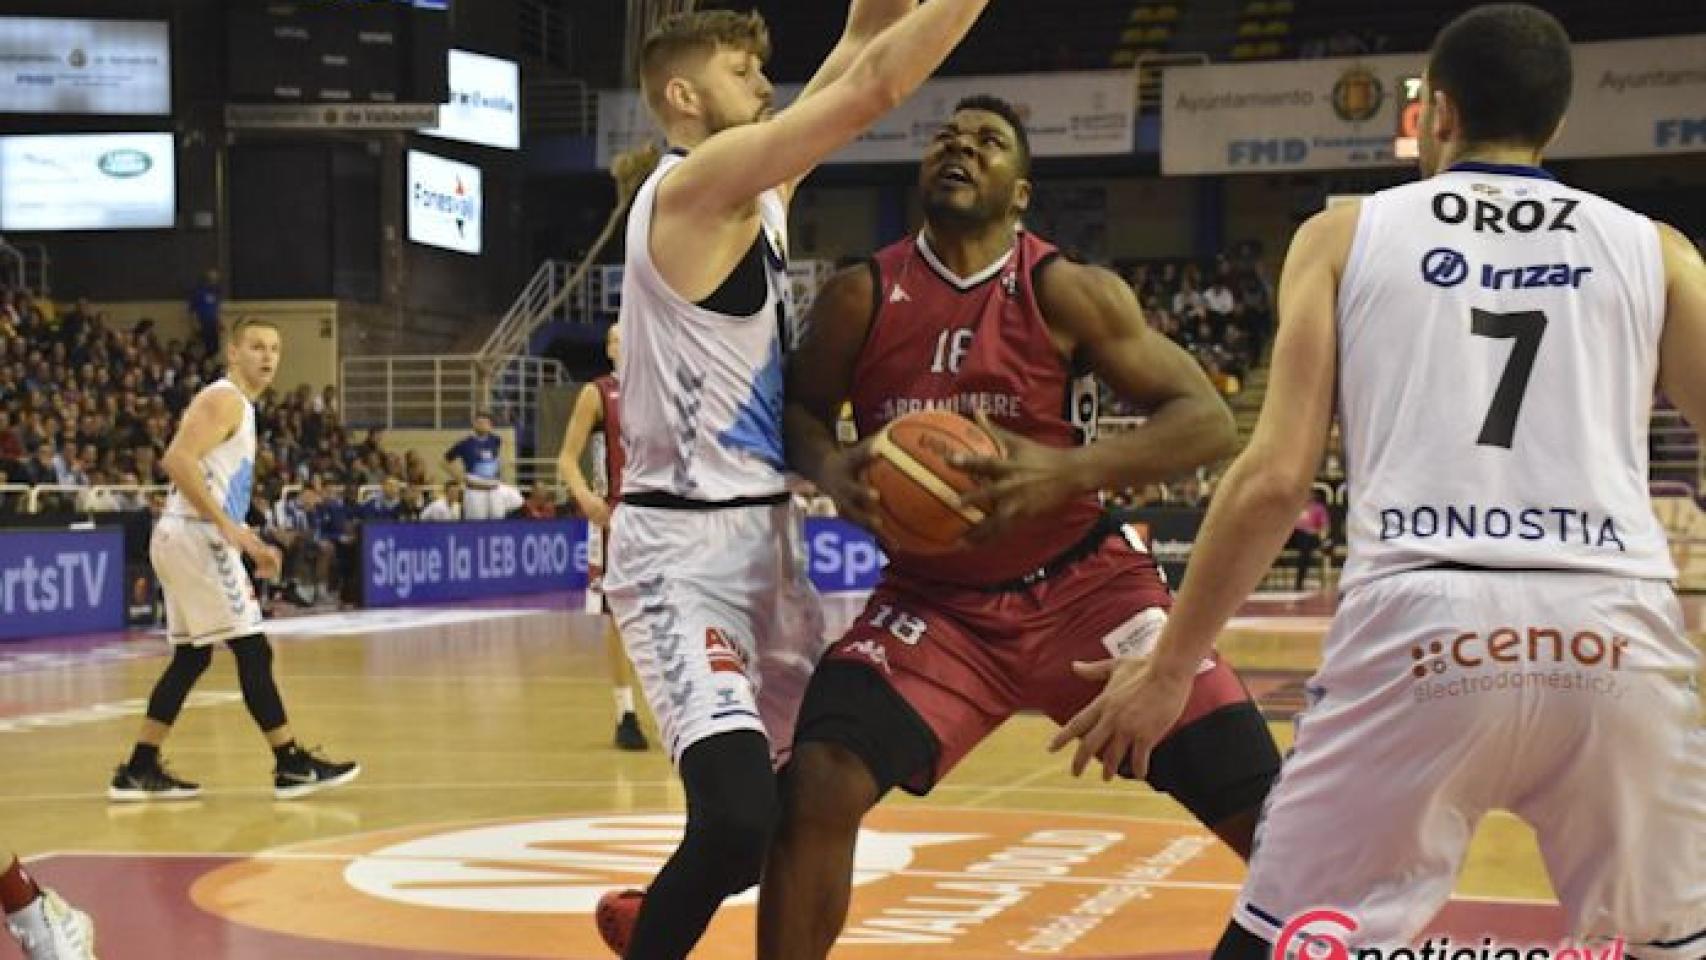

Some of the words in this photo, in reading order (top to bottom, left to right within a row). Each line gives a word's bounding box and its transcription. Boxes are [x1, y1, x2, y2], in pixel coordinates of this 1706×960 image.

[1227, 139, 1308, 166] FMD
[1432, 191, 1580, 234] OROZ
[1480, 263, 1592, 289] Irizar
[1470, 307, 1549, 449] 7
[1379, 505, 1626, 552] DONOSTIA
[0, 550, 108, 614] rtsTV
[372, 537, 442, 598] Sigue
[448, 534, 472, 580] la
[477, 534, 516, 579] LEB
[521, 533, 568, 577] ORO
[804, 531, 890, 586] Sp
[869, 604, 927, 646] 18
[1453, 624, 1629, 673] cenor
